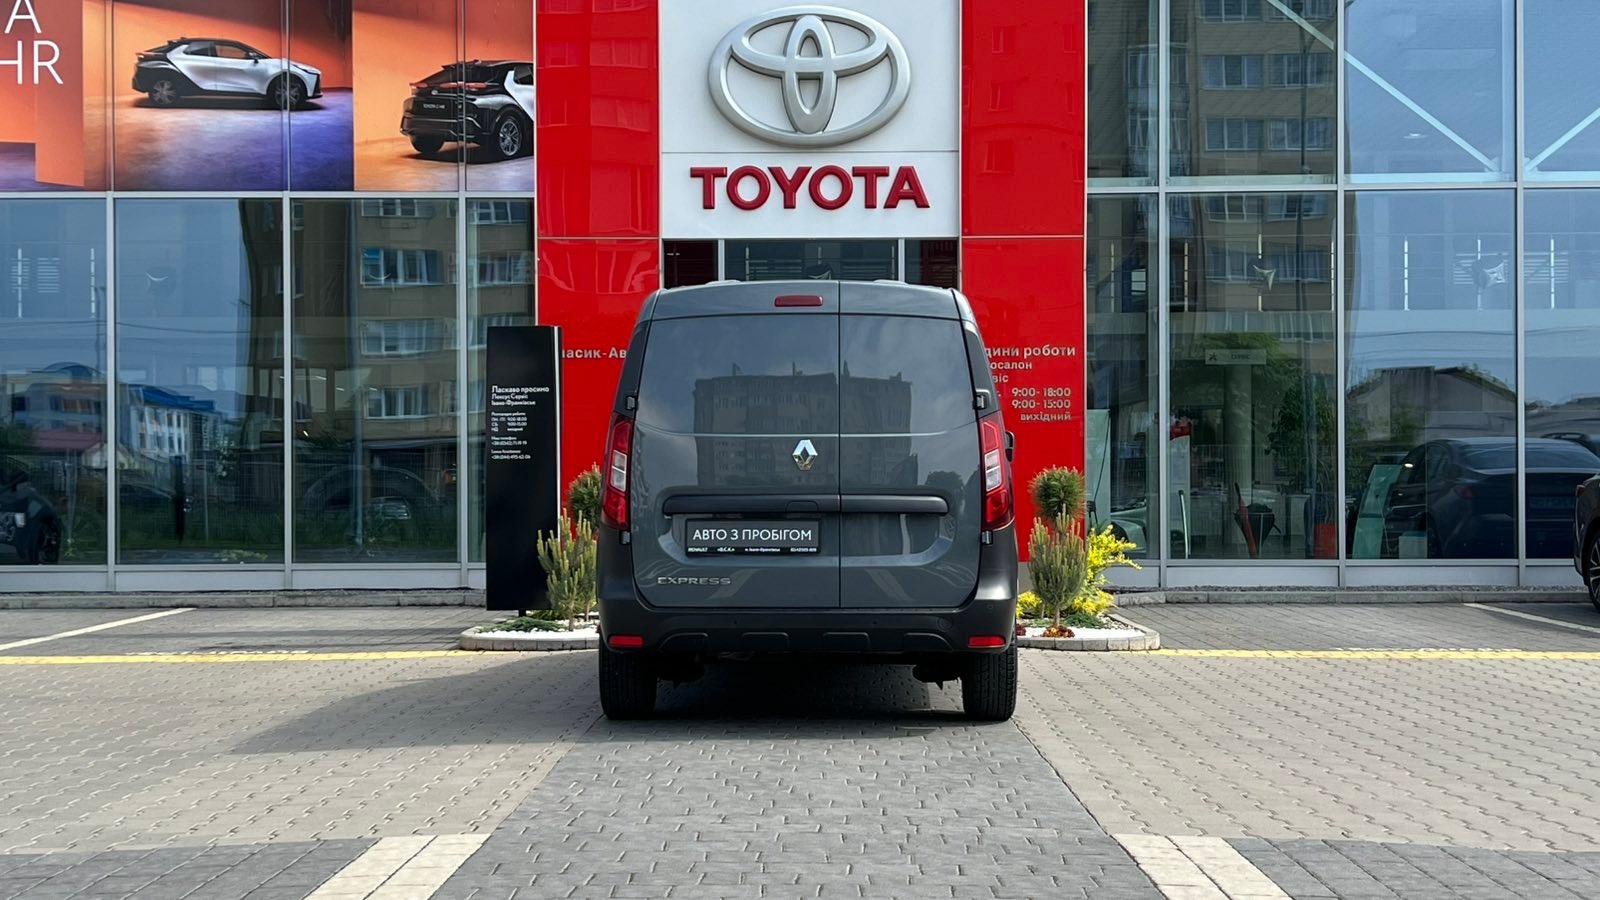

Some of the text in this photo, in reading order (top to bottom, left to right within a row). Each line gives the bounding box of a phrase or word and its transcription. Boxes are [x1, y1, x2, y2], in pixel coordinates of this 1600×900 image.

[690, 165, 930, 211] TOYOTA
[1023, 344, 1076, 359] роботи
[1020, 411, 1072, 422] вихідний
[692, 529, 728, 541] АВТО
[742, 529, 812, 541] ПРОБІГОМ
[657, 576, 732, 585] EXPRESS
